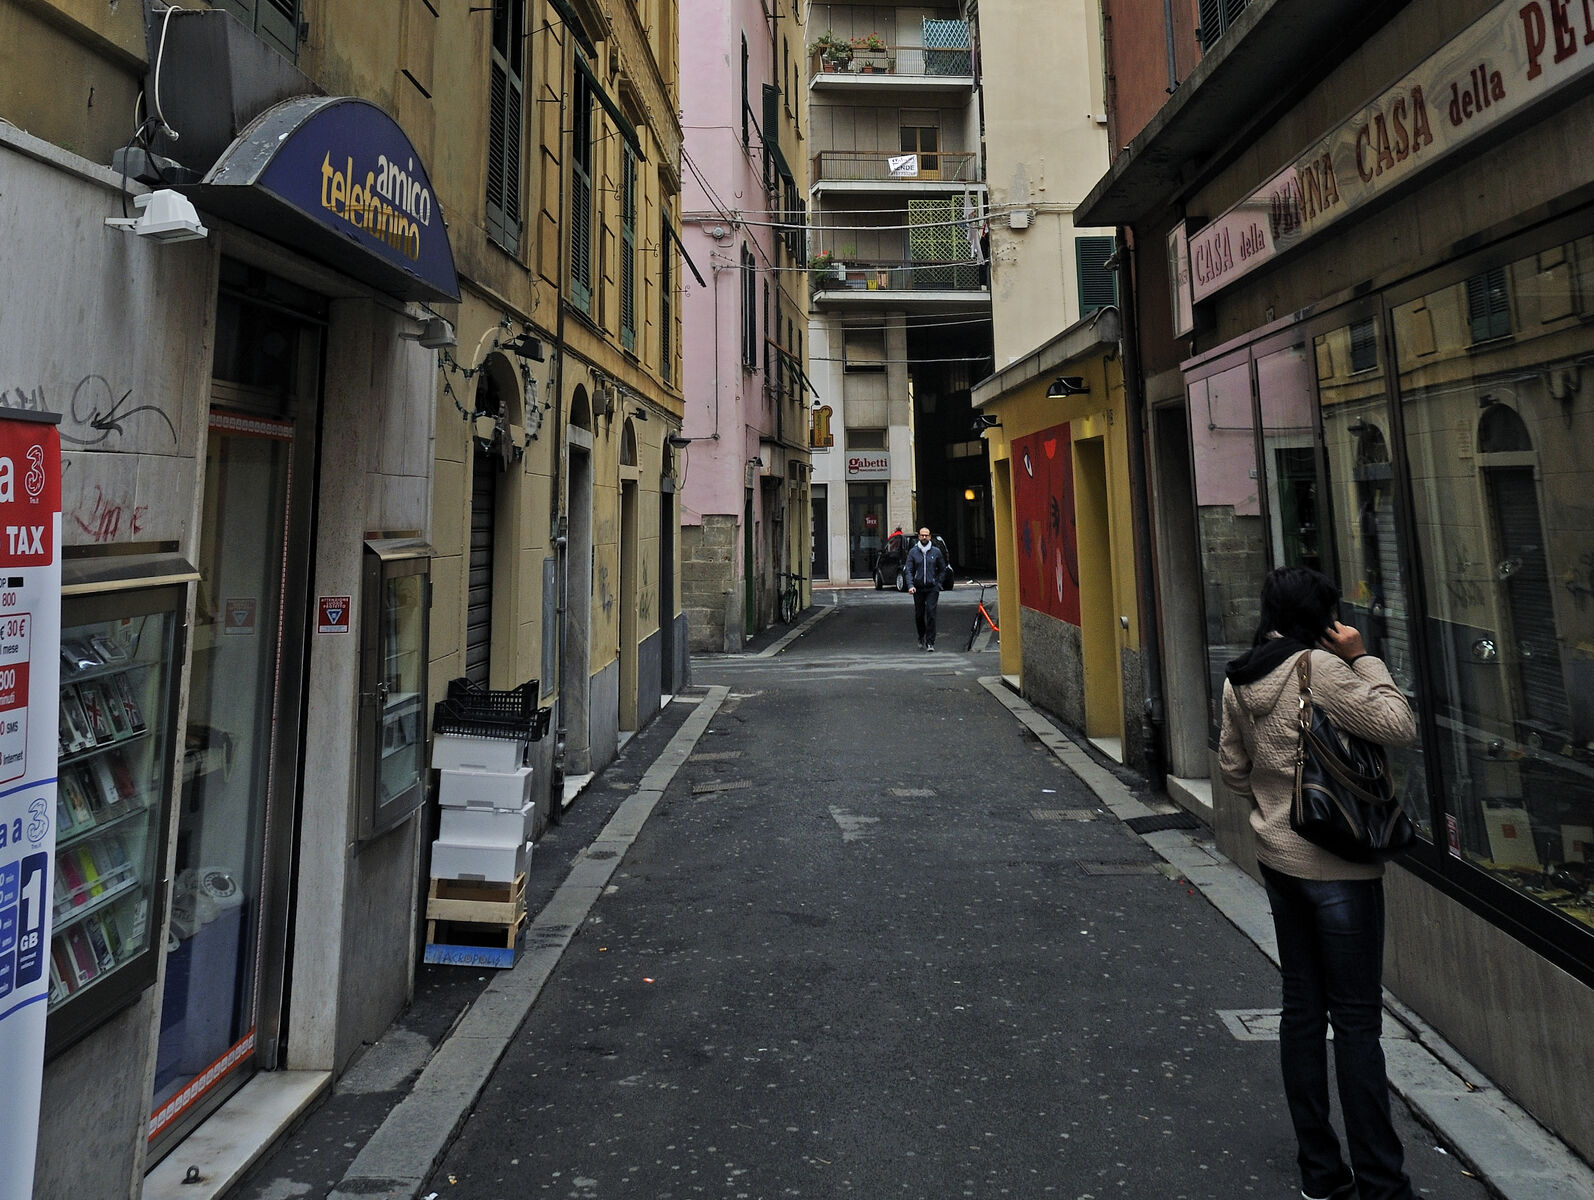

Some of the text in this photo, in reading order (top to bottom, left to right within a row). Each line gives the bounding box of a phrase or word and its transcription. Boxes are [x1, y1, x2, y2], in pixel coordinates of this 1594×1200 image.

[376, 154, 430, 227] amico
[1196, 226, 1233, 286] CASA
[1240, 223, 1265, 261] della
[1272, 152, 1339, 240] PENNA
[1356, 85, 1433, 183] CASA
[1449, 64, 1506, 127] della
[321, 150, 420, 262] telefonino
[848, 457, 888, 474] gabetti
[6, 526, 44, 555] TAX
[27, 798, 49, 842] 3
[22, 868, 42, 932] 1
[20, 932, 38, 952] GB
